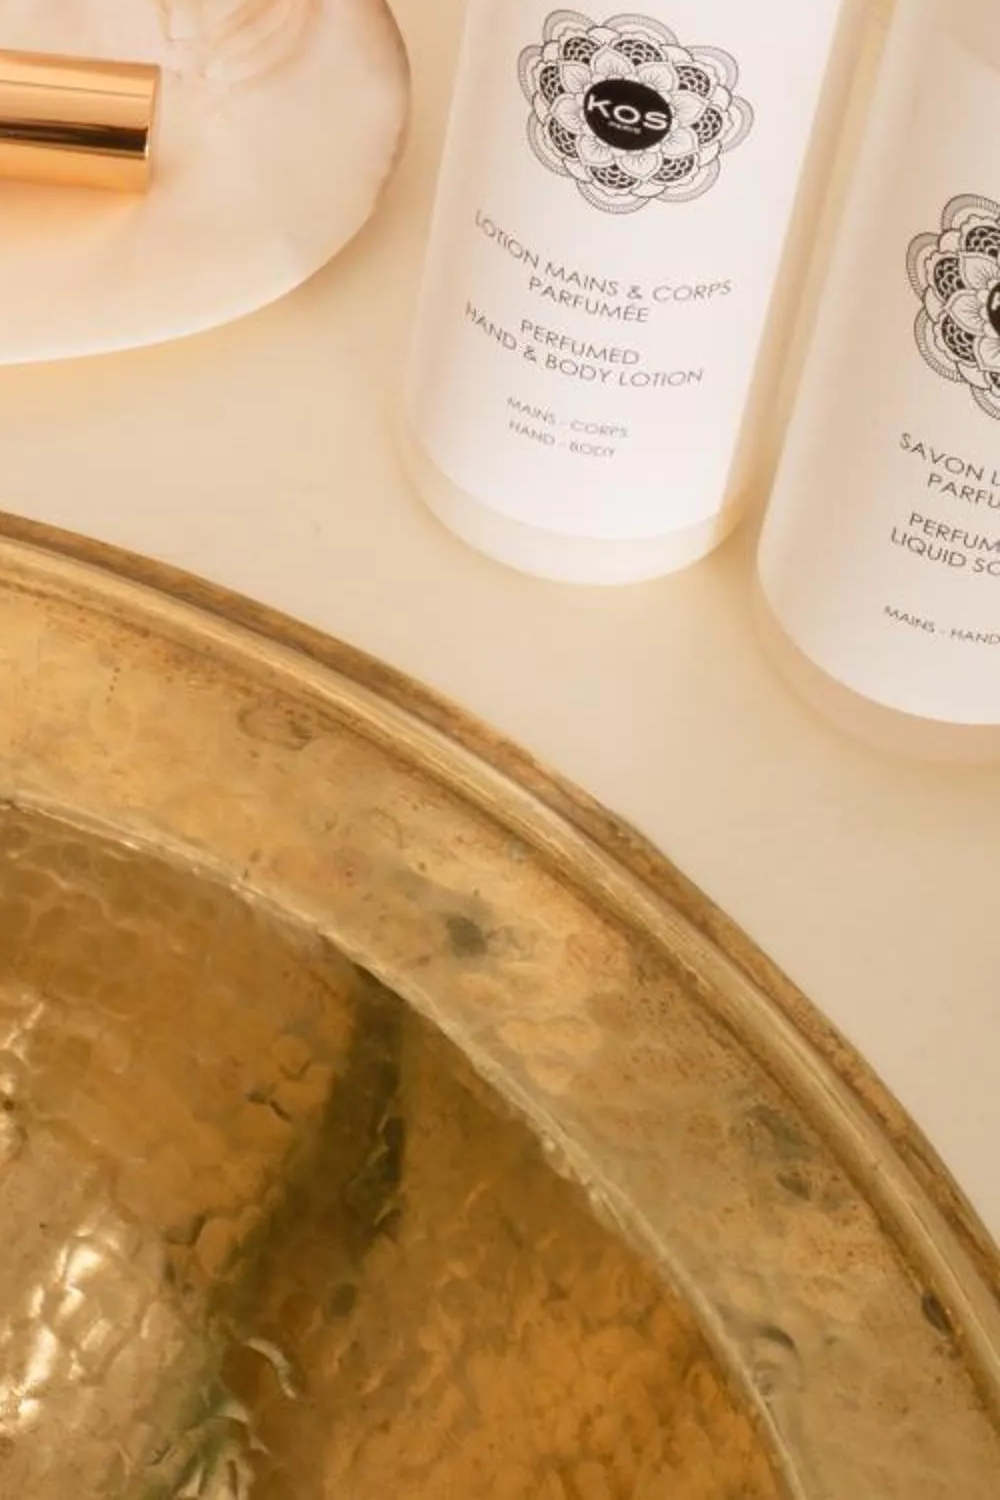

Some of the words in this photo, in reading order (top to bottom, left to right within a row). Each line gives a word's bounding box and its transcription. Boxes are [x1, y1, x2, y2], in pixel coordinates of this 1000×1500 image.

[587, 93, 668, 130] KOS
[474, 209, 540, 269] LOTION
[544, 261, 619, 297] MAINS
[626, 284, 644, 301] &
[652, 279, 733, 302] CORPS
[528, 276, 651, 323] PARFUMÉE
[465, 301, 518, 351] HAND
[523, 344, 538, 364] &
[545, 352, 612, 383] BODY
[618, 368, 704, 388] LOTION
[519, 319, 640, 366] PERFUMED
[899, 432, 985, 482] SAVON
[890, 525, 968, 568] LIQUID
[884, 605, 936, 634] MAINS
